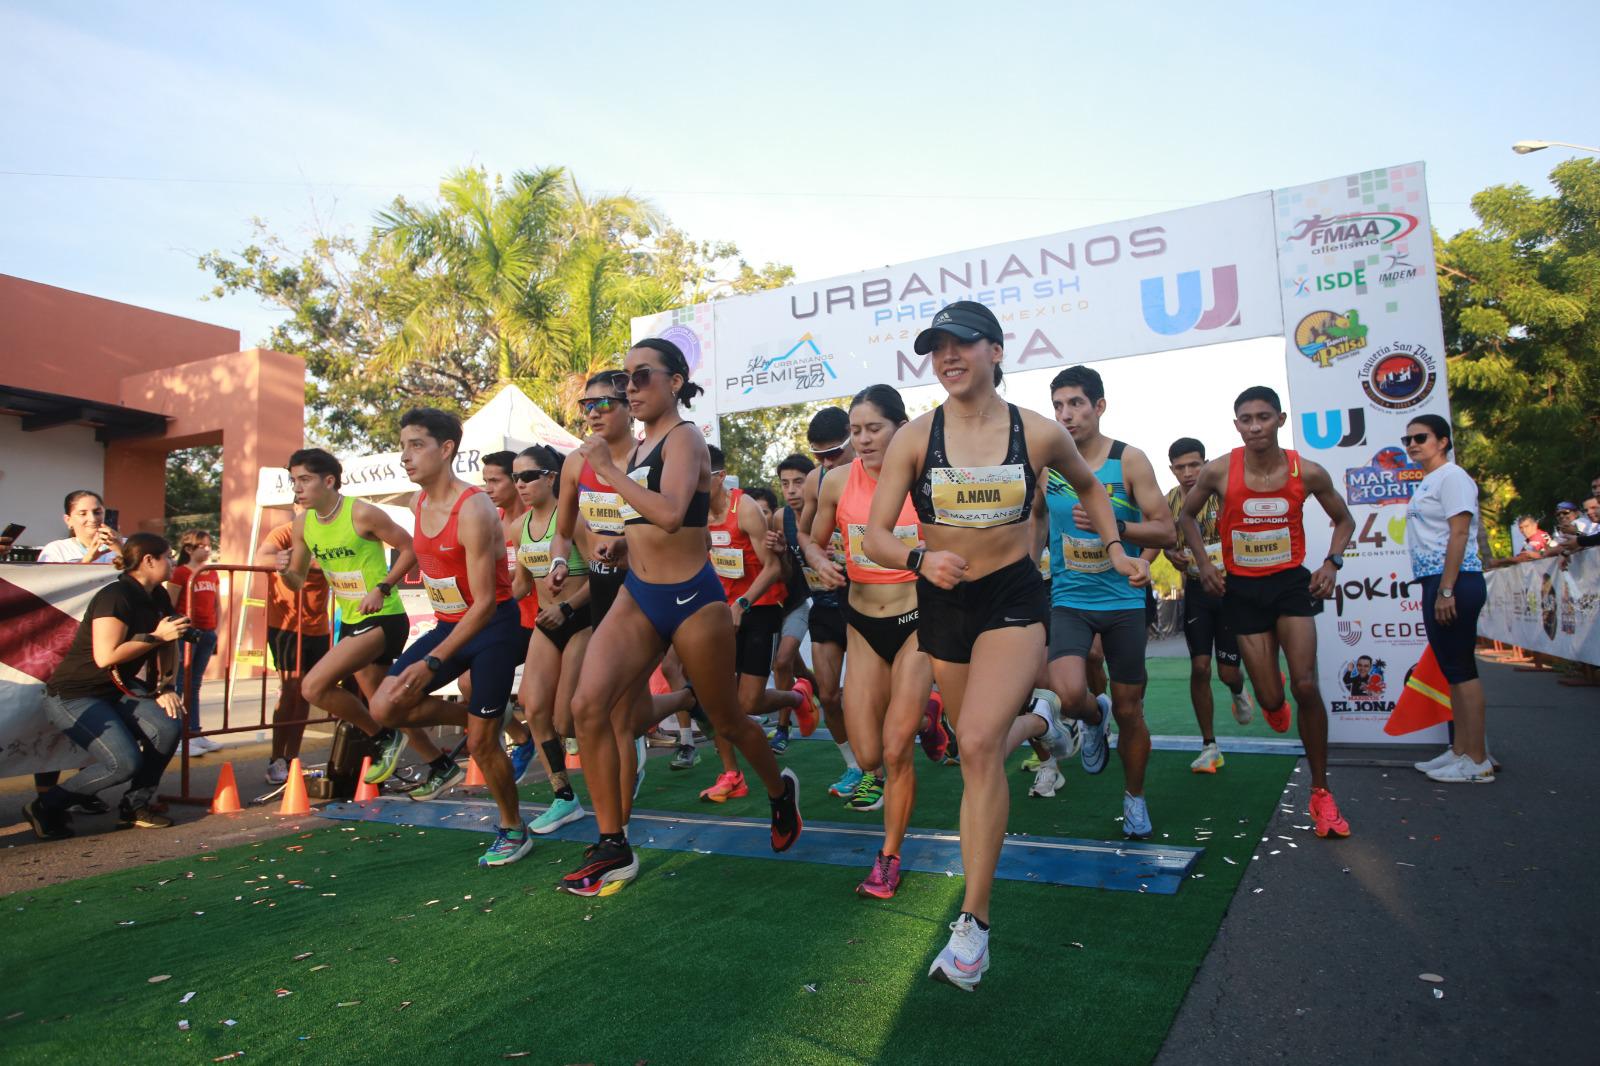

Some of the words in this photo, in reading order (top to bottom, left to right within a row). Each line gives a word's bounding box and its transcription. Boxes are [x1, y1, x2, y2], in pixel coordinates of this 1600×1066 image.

[1311, 220, 1380, 246] FMAA
[1311, 239, 1380, 255] atletismo
[791, 226, 1168, 320] URBANIANOS
[1316, 269, 1367, 291] ISDE
[1379, 268, 1417, 282] IMDEM
[1033, 275, 1081, 300] SH
[1002, 300, 1089, 322] MEXICO
[773, 354, 834, 368] URBANIANOS
[896, 327, 1064, 381] MA
[1393, 341, 1413, 352] San
[1413, 344, 1437, 371] Pablo
[726, 363, 823, 390] PREMIER
[796, 372, 825, 390] 2023
[1350, 471, 1394, 486] MAR
[956, 489, 1001, 504] A.NAVA
[590, 508, 596, 517] F.
[1082, 550, 1103, 559] CRUZ
[1245, 544, 1253, 553] R.
[1254, 543, 1279, 553] REYES
[1361, 549, 1407, 557] CONSTRUC
[898, 610, 919, 625] NIKE
[1331, 701, 1352, 712] EL
[1354, 701, 1397, 713] JONA
